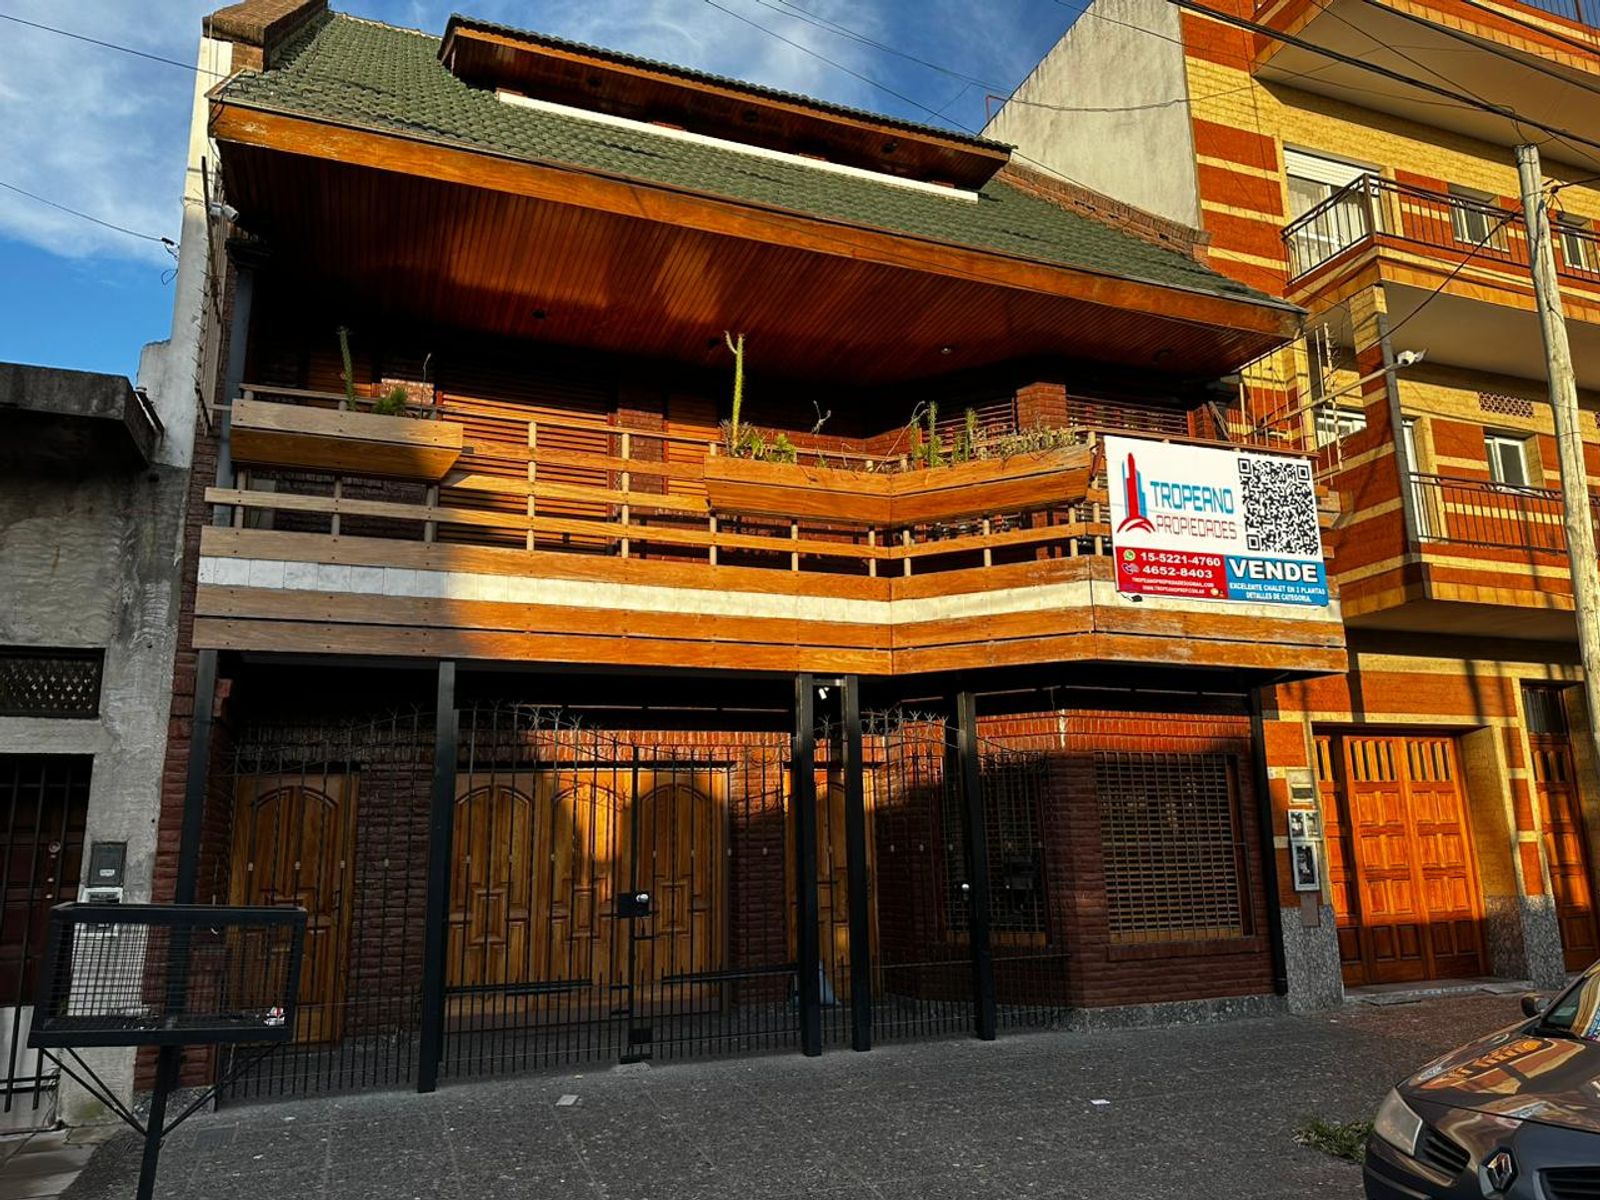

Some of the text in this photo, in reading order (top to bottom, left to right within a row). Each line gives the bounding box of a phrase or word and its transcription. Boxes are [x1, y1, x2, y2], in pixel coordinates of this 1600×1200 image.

[1150, 481, 1234, 514] TROPEANO
[1156, 514, 1237, 540] PROPIEDADES
[1140, 552, 1221, 567] 15-5221-4760
[1142, 565, 1213, 578] 4652-8403
[1229, 559, 1318, 583] VENDE
[1229, 582, 1262, 591] EXCELENTE
